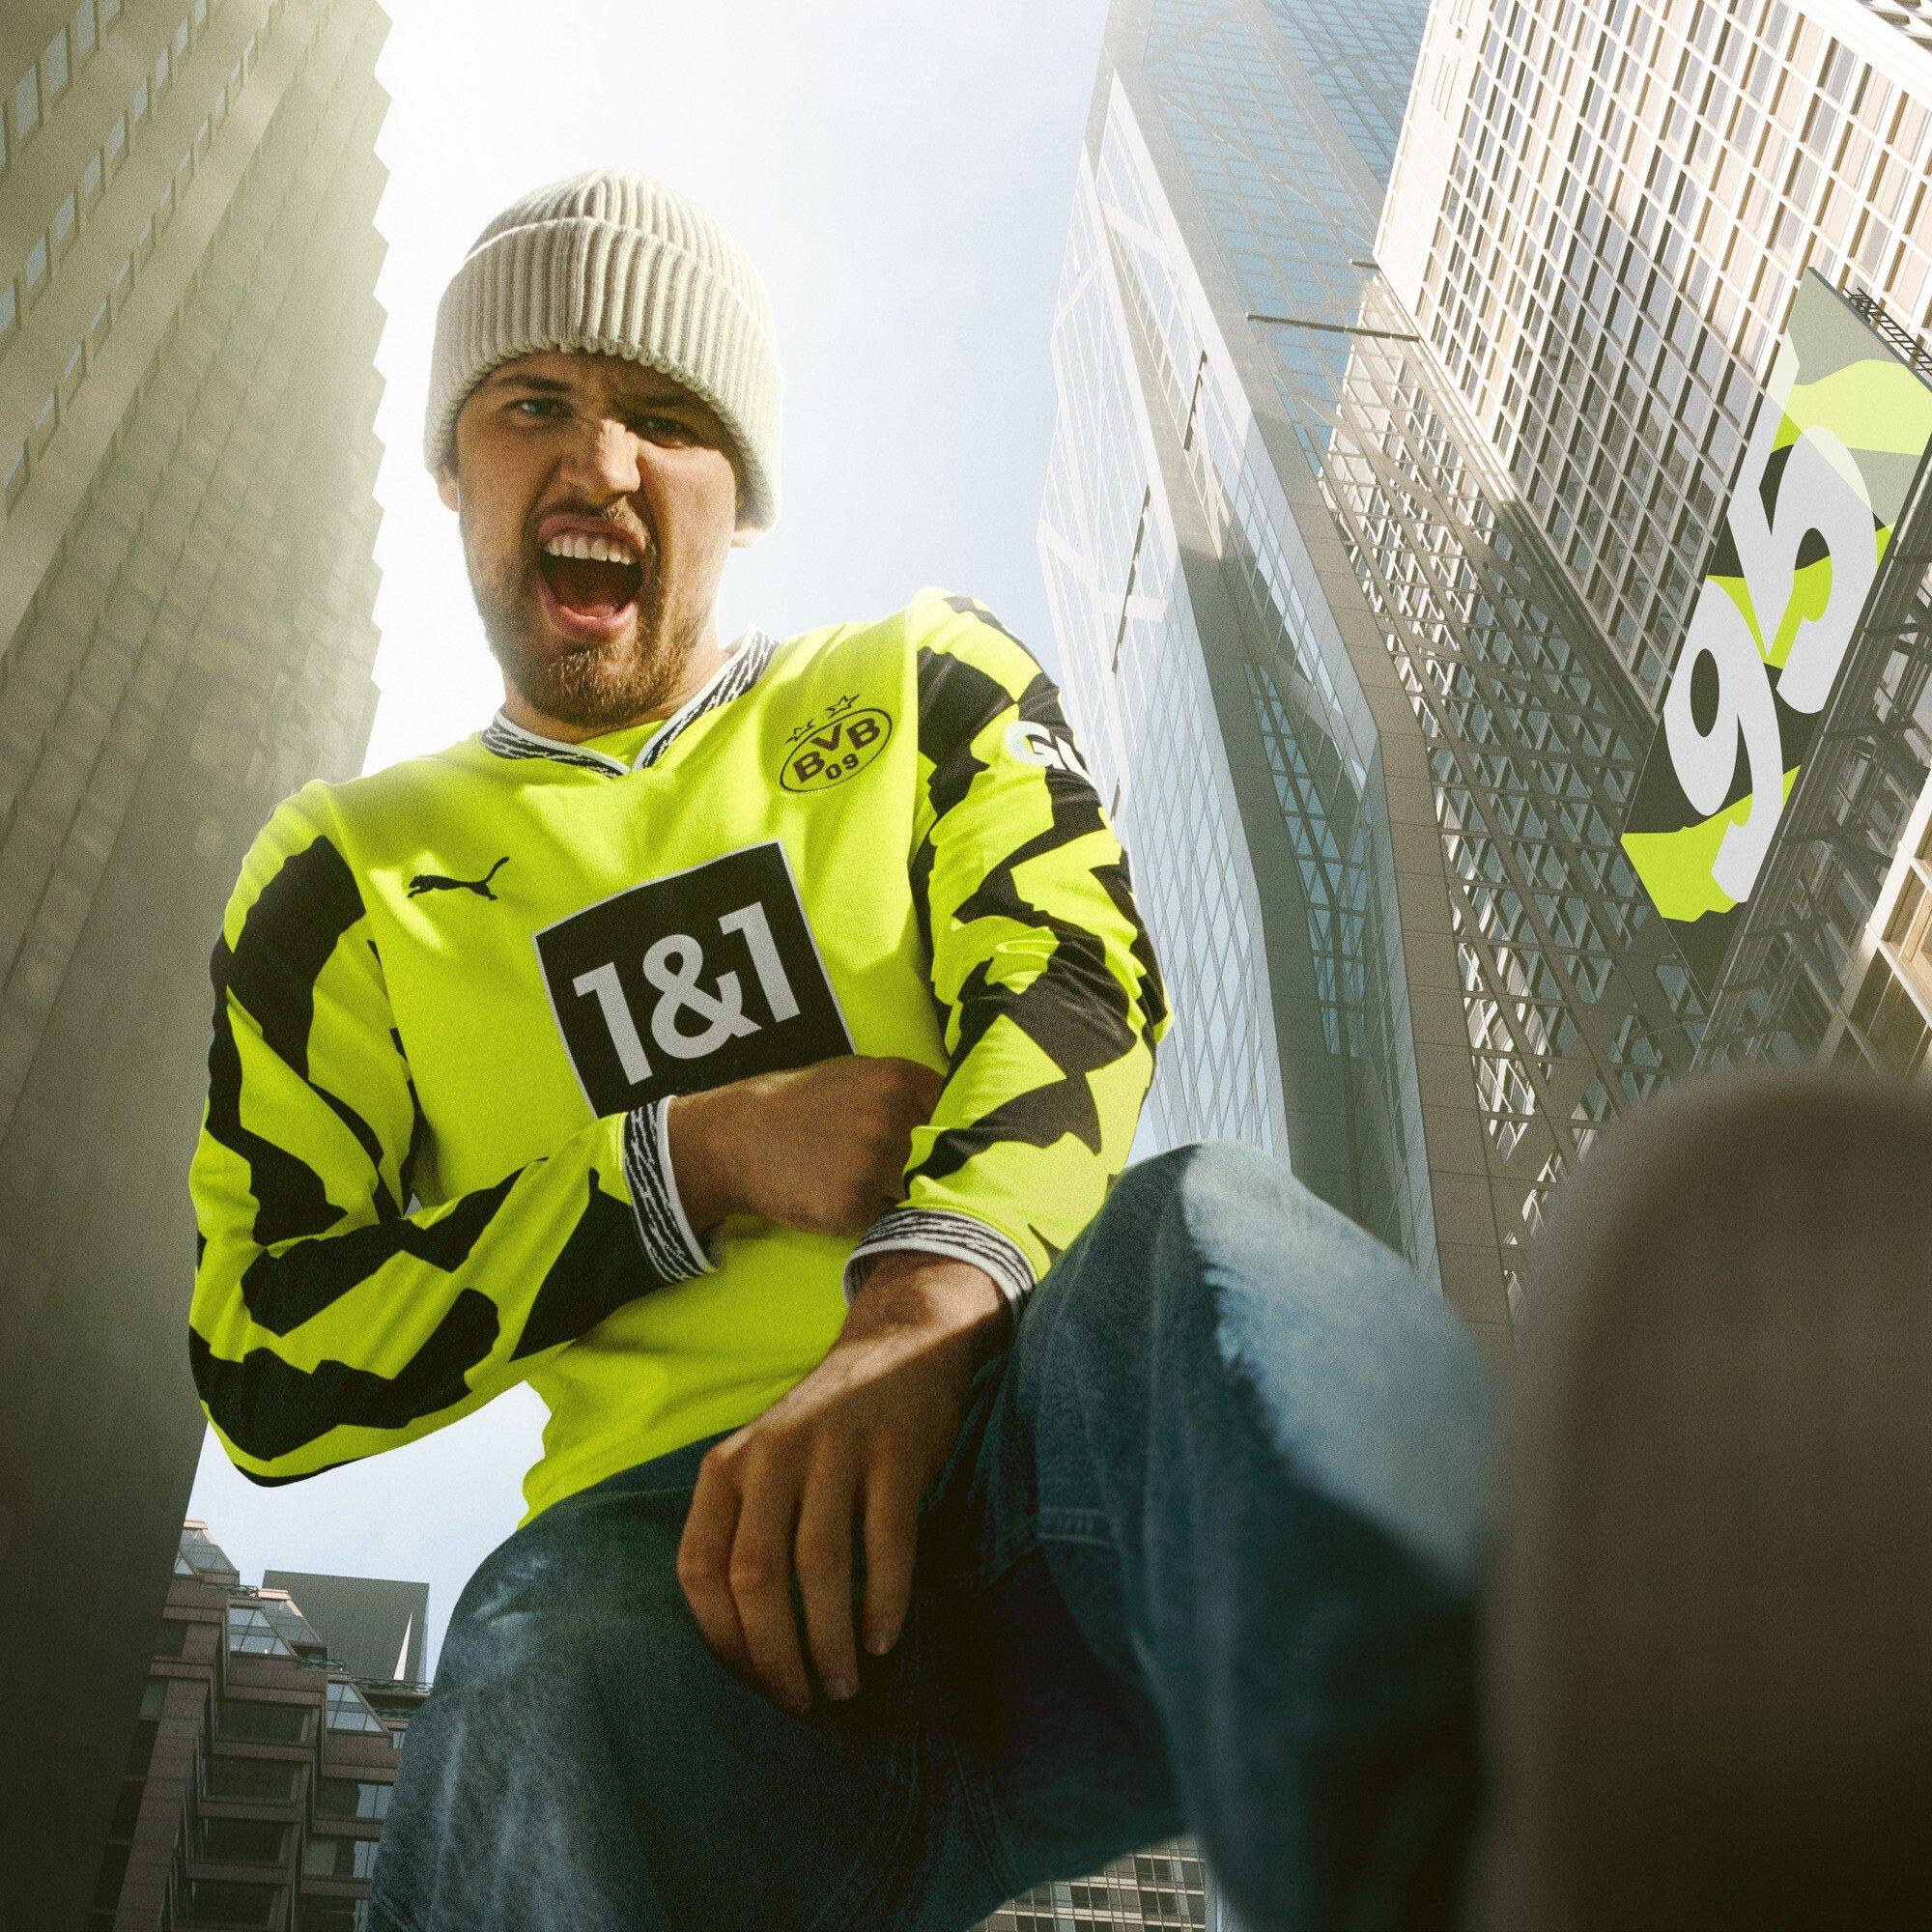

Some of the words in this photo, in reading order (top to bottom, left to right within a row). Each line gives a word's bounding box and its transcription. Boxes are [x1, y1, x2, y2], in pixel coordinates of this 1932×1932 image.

[1663, 327, 1877, 902] 95
[792, 718, 880, 783] BVB
[825, 753, 859, 780] 09
[572, 901, 800, 1085] 1&1
